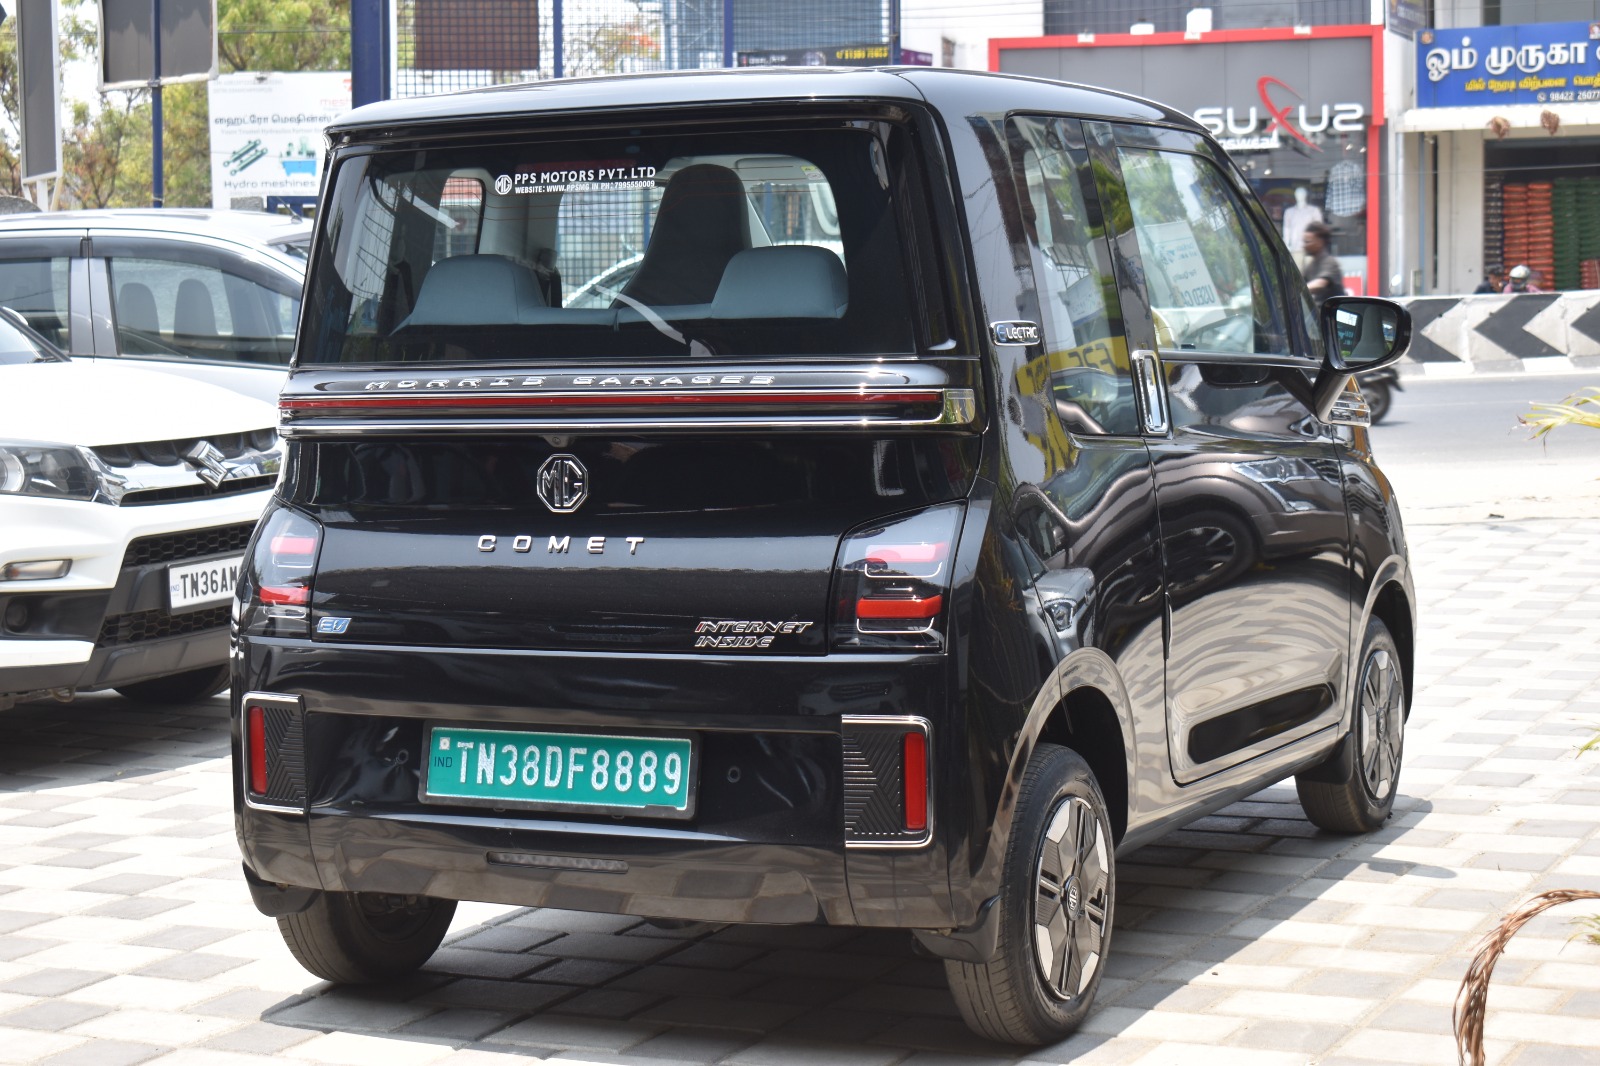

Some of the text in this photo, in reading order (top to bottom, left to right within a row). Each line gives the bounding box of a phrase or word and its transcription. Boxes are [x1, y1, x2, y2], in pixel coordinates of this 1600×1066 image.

[1426, 36, 1478, 81] ஓம்
[1485, 42, 1588, 75] முருகா
[514, 166, 656, 185] PPS MOTORS PVT. LTD
[224, 180, 258, 189] Hydro
[495, 175, 512, 194] MG
[514, 186, 545, 194] WEBSITE:
[997, 324, 1038, 342] ELECTRIC
[365, 375, 775, 390] MORRIS GARAGES
[539, 456, 586, 510] MG
[477, 535, 645, 554] COMET
[319, 619, 349, 632] EV
[694, 620, 814, 634] INTERNET
[694, 635, 775, 648] INSIDE
[433, 756, 453, 768] IND
[457, 741, 683, 795] TN38DF8889
